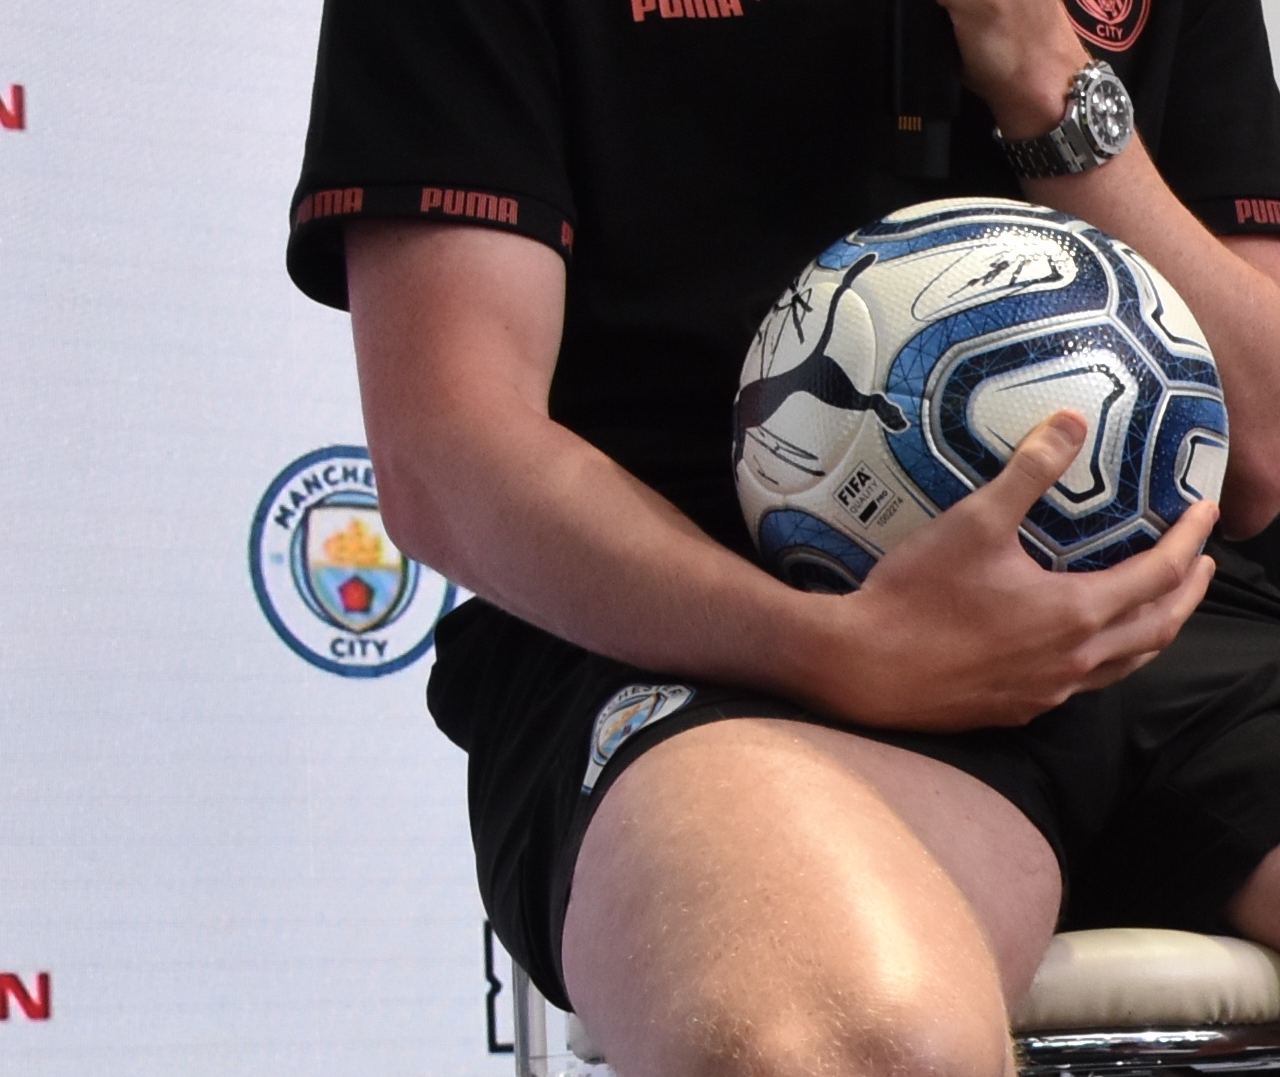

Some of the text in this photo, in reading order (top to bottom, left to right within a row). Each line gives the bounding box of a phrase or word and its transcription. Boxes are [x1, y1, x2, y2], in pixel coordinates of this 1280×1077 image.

[1096, 24, 1124, 41] CITY
[420, 187, 519, 226] PUMA
[273, 466, 377, 530] MANCHE
[837, 470, 872, 507] FIFA
[849, 480, 879, 515] QUALITY
[330, 637, 388, 658] CITY
